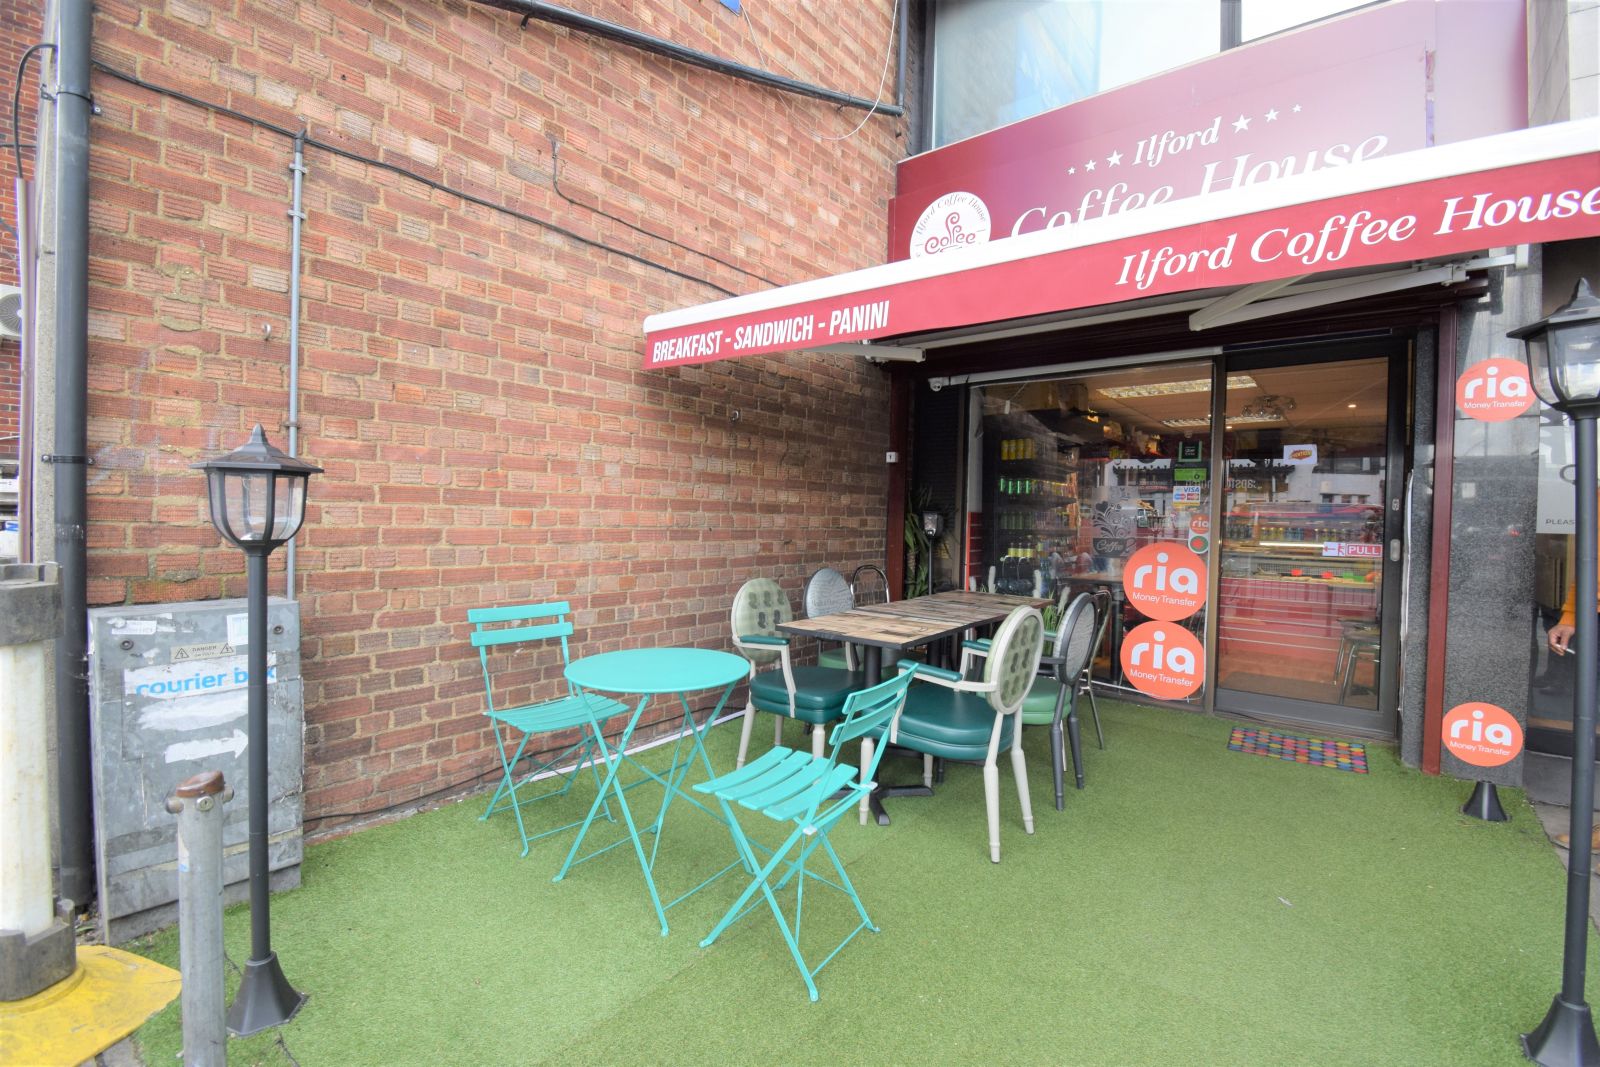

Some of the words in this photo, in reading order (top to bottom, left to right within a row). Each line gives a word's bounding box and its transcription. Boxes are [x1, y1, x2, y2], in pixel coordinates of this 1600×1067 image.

[1131, 116, 1223, 168] Ilford
[1010, 182, 1174, 238] Coffee
[1199, 134, 1389, 198] House
[937, 193, 967, 209] Coffee
[968, 197, 986, 221] House
[1114, 233, 1238, 290] Ilford
[1250, 210, 1416, 266] Coffee
[1434, 185, 1600, 236] House
[652, 330, 723, 363] BREAKFAST
[733, 314, 814, 350] SANDWICH
[829, 300, 890, 336] PANINI
[1464, 366, 1527, 399] ria
[1464, 401, 1491, 409] Money
[1493, 400, 1526, 408] Transfer
[1348, 545, 1377, 555] PULL
[1133, 552, 1198, 595] ria
[1132, 592, 1160, 604] Money
[1161, 595, 1197, 607] Transfer
[1130, 630, 1195, 675] ria
[135, 673, 227, 696] courier
[234, 666, 276, 684] bx
[1130, 669, 1158, 682] Money
[1159, 673, 1194, 687] Transfer
[1450, 710, 1512, 746] ria
[1449, 741, 1477, 751] Money
[1478, 745, 1511, 756] Transfer
